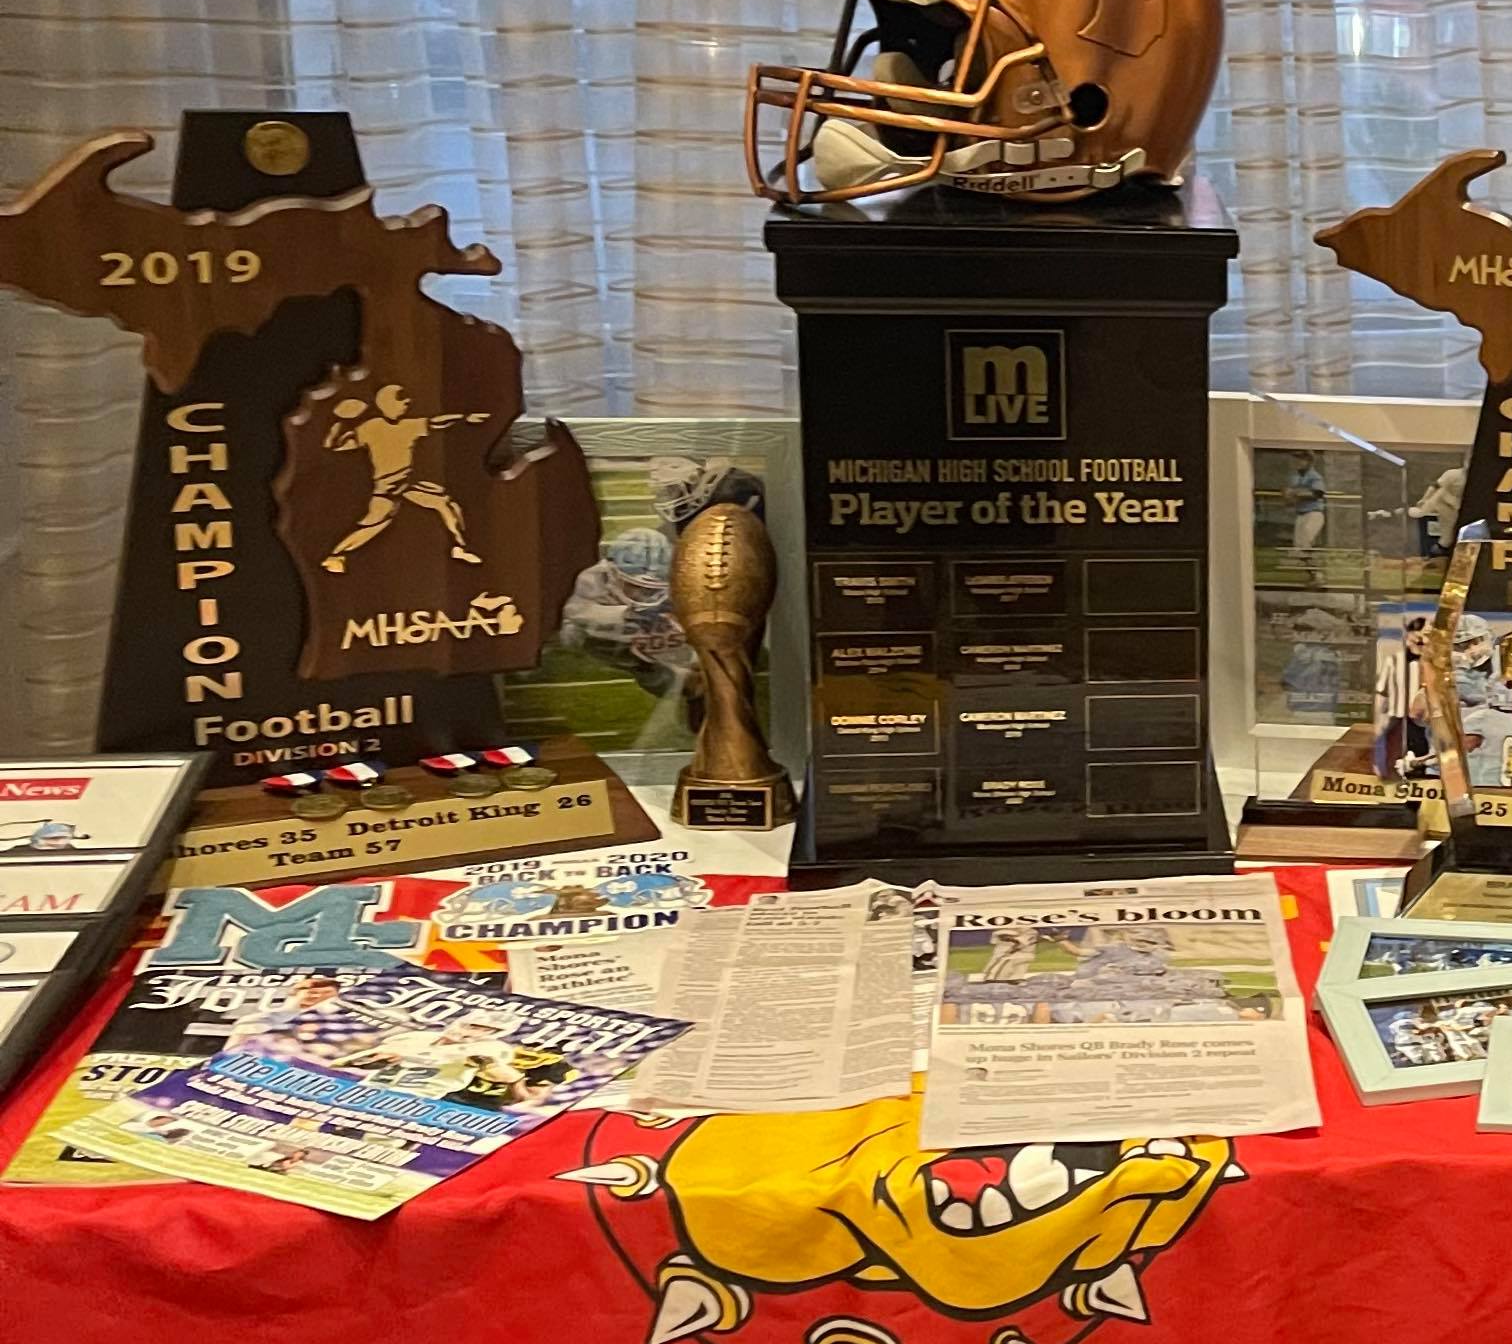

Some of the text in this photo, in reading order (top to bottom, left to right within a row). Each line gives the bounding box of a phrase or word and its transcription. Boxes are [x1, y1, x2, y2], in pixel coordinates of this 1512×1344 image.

[953, 176, 1035, 192] Riddell
[100, 249, 262, 287] 2019
[964, 394, 1049, 424] LIVE
[828, 458, 1183, 484] MICHIGAN HIGH SCHOOL FOOTBALL
[829, 491, 1184, 534] Player of the Year
[167, 402, 244, 703] CHAMPION
[341, 607, 498, 651] MHSAA
[194, 694, 415, 747] Football
[233, 738, 382, 767] DIVISION 2
[0, 782, 82, 797] News
[1321, 776, 1386, 797] Mona
[1479, 801, 1508, 818] 25
[177, 794, 593, 859] hores 35 Detroit King 26
[268, 837, 402, 868] Team 57
[464, 860, 542, 876] 2019
[607, 850, 689, 865] 2020
[478, 868, 557, 886] BACK
[595, 862, 673, 880] BACK
[445, 910, 680, 939] CHAMPION
[954, 906, 1265, 928] Rose's bloom
[540, 970, 595, 982] Rose
[967, 1038, 1255, 1053] Mona Shores QB Brady Rose comes
[1036, 1052, 1053, 1062] in
[1191, 1049, 1203, 1058] 2
[1205, 1047, 1257, 1059] repeat
[371, 1096, 435, 1118] who
[432, 1109, 519, 1135] could
